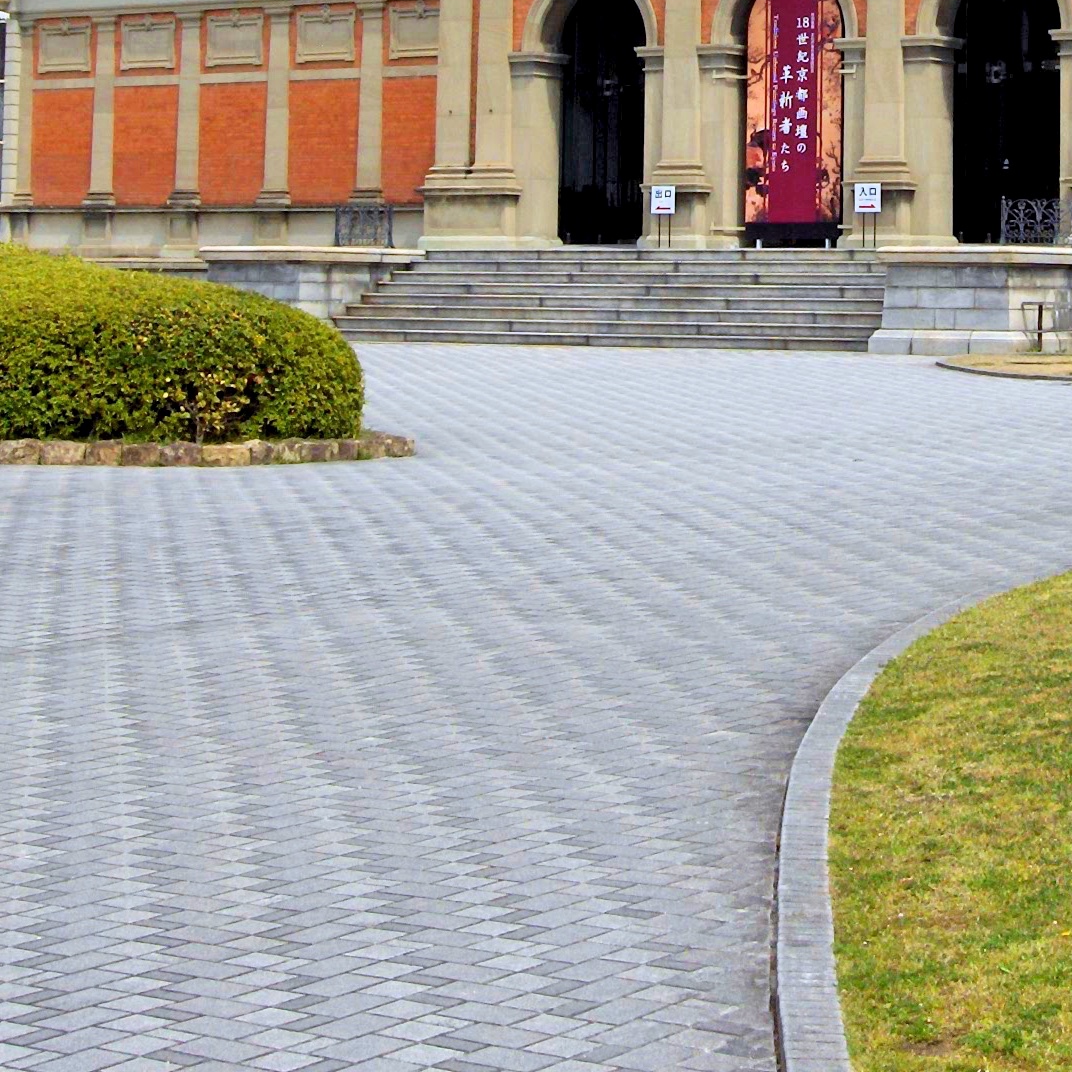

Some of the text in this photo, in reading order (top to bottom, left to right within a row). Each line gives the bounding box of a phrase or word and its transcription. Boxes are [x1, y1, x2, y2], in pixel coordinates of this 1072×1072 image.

[795, 17, 810, 154] 18世紀京都画壇の
[779, 65, 794, 173] 革新者たち
[655, 189, 671, 198] 出口
[859, 187, 876, 196] 入口
